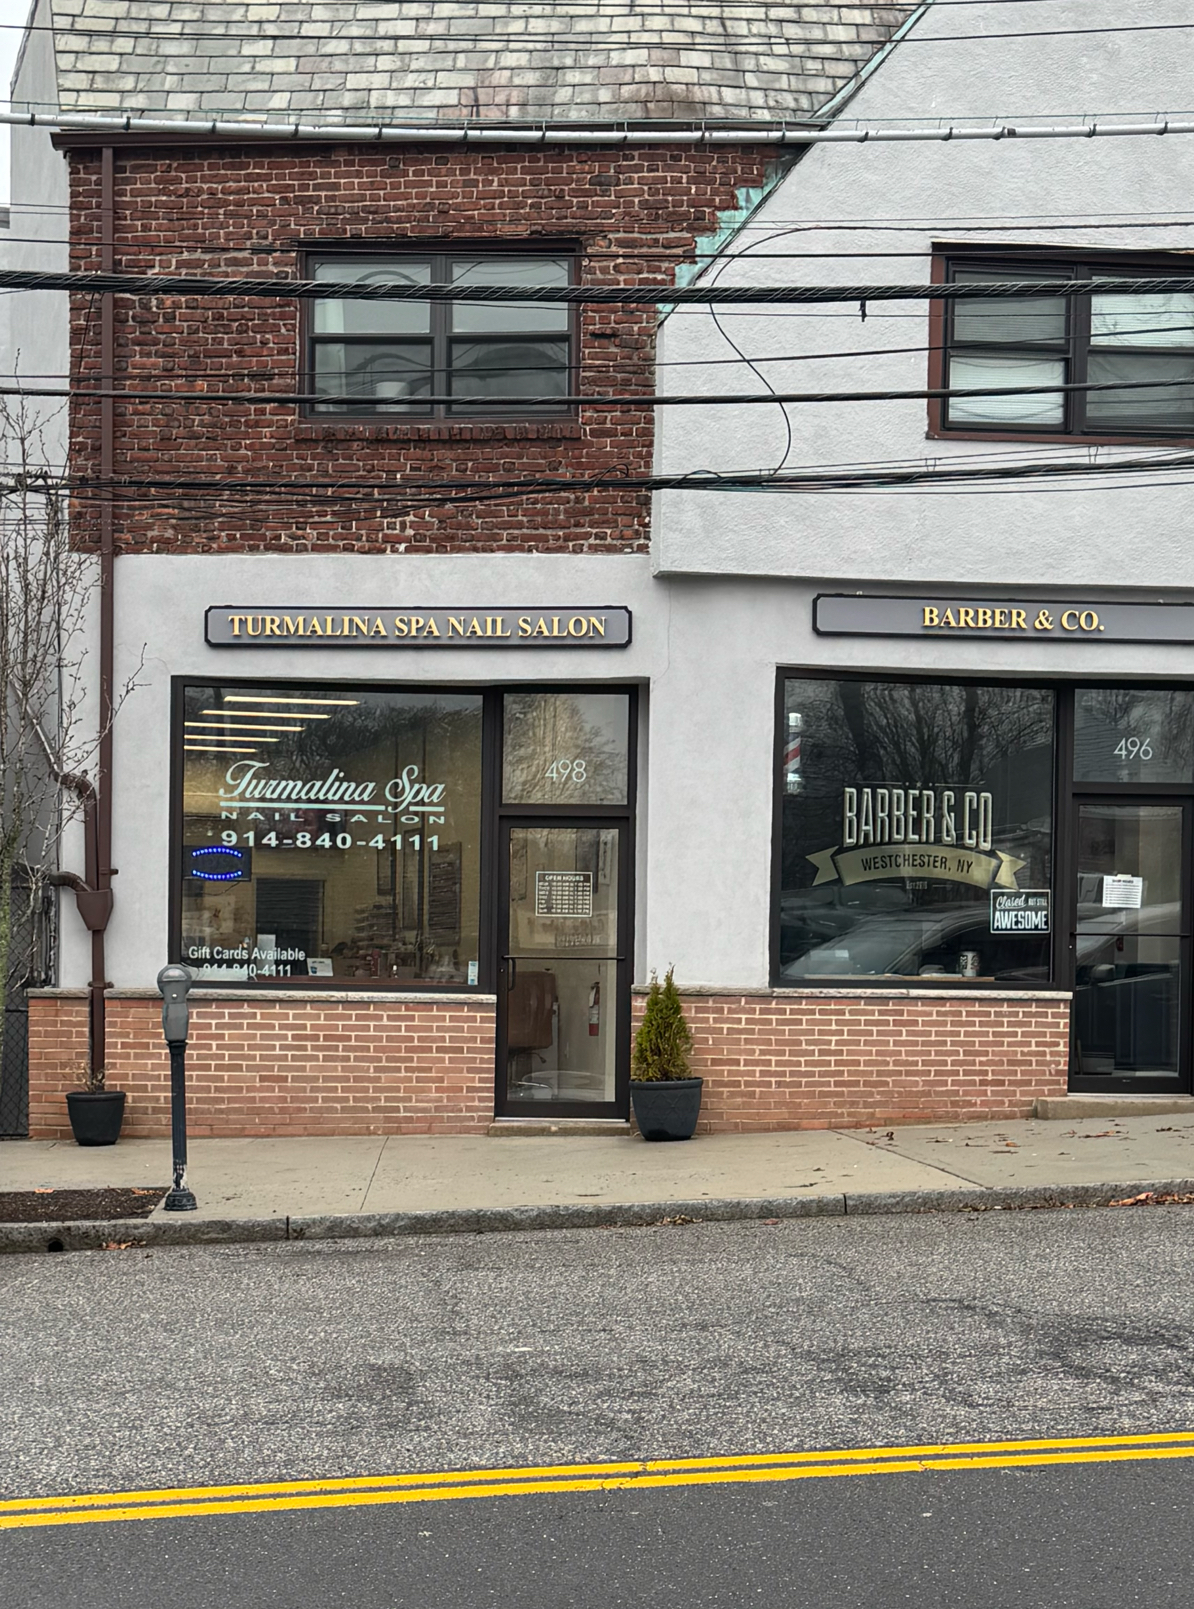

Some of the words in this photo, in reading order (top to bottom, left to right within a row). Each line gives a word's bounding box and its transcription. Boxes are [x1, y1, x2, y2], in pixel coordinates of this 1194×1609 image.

[228, 615, 388, 636] TURMALINA
[394, 616, 440, 637] SPA
[447, 616, 511, 637] NAIL
[518, 616, 606, 637] SALON
[923, 606, 1028, 629] BARBER
[1034, 609, 1054, 630] &
[1061, 609, 1105, 631] CO.
[1113, 737, 1153, 760] 496
[545, 759, 586, 782] 498
[219, 760, 377, 800] Turmalina
[385, 764, 446, 813] Spa
[221, 811, 305, 822] NAIL
[325, 813, 445, 824] SALON
[843, 787, 935, 848] BARBER
[941, 791, 957, 846] &
[964, 792, 992, 851] CO
[221, 830, 439, 850] 914-840-4111
[861, 853, 952, 873] WESTCHESTER,
[956, 859, 973, 874] NY
[996, 894, 1027, 909] Closed
[994, 911, 1048, 929] AWESOME
[188, 946, 210, 959] Gift
[213, 946, 249, 960] Cards
[251, 947, 306, 961] Available
[203, 963, 291, 977] 0-4111
